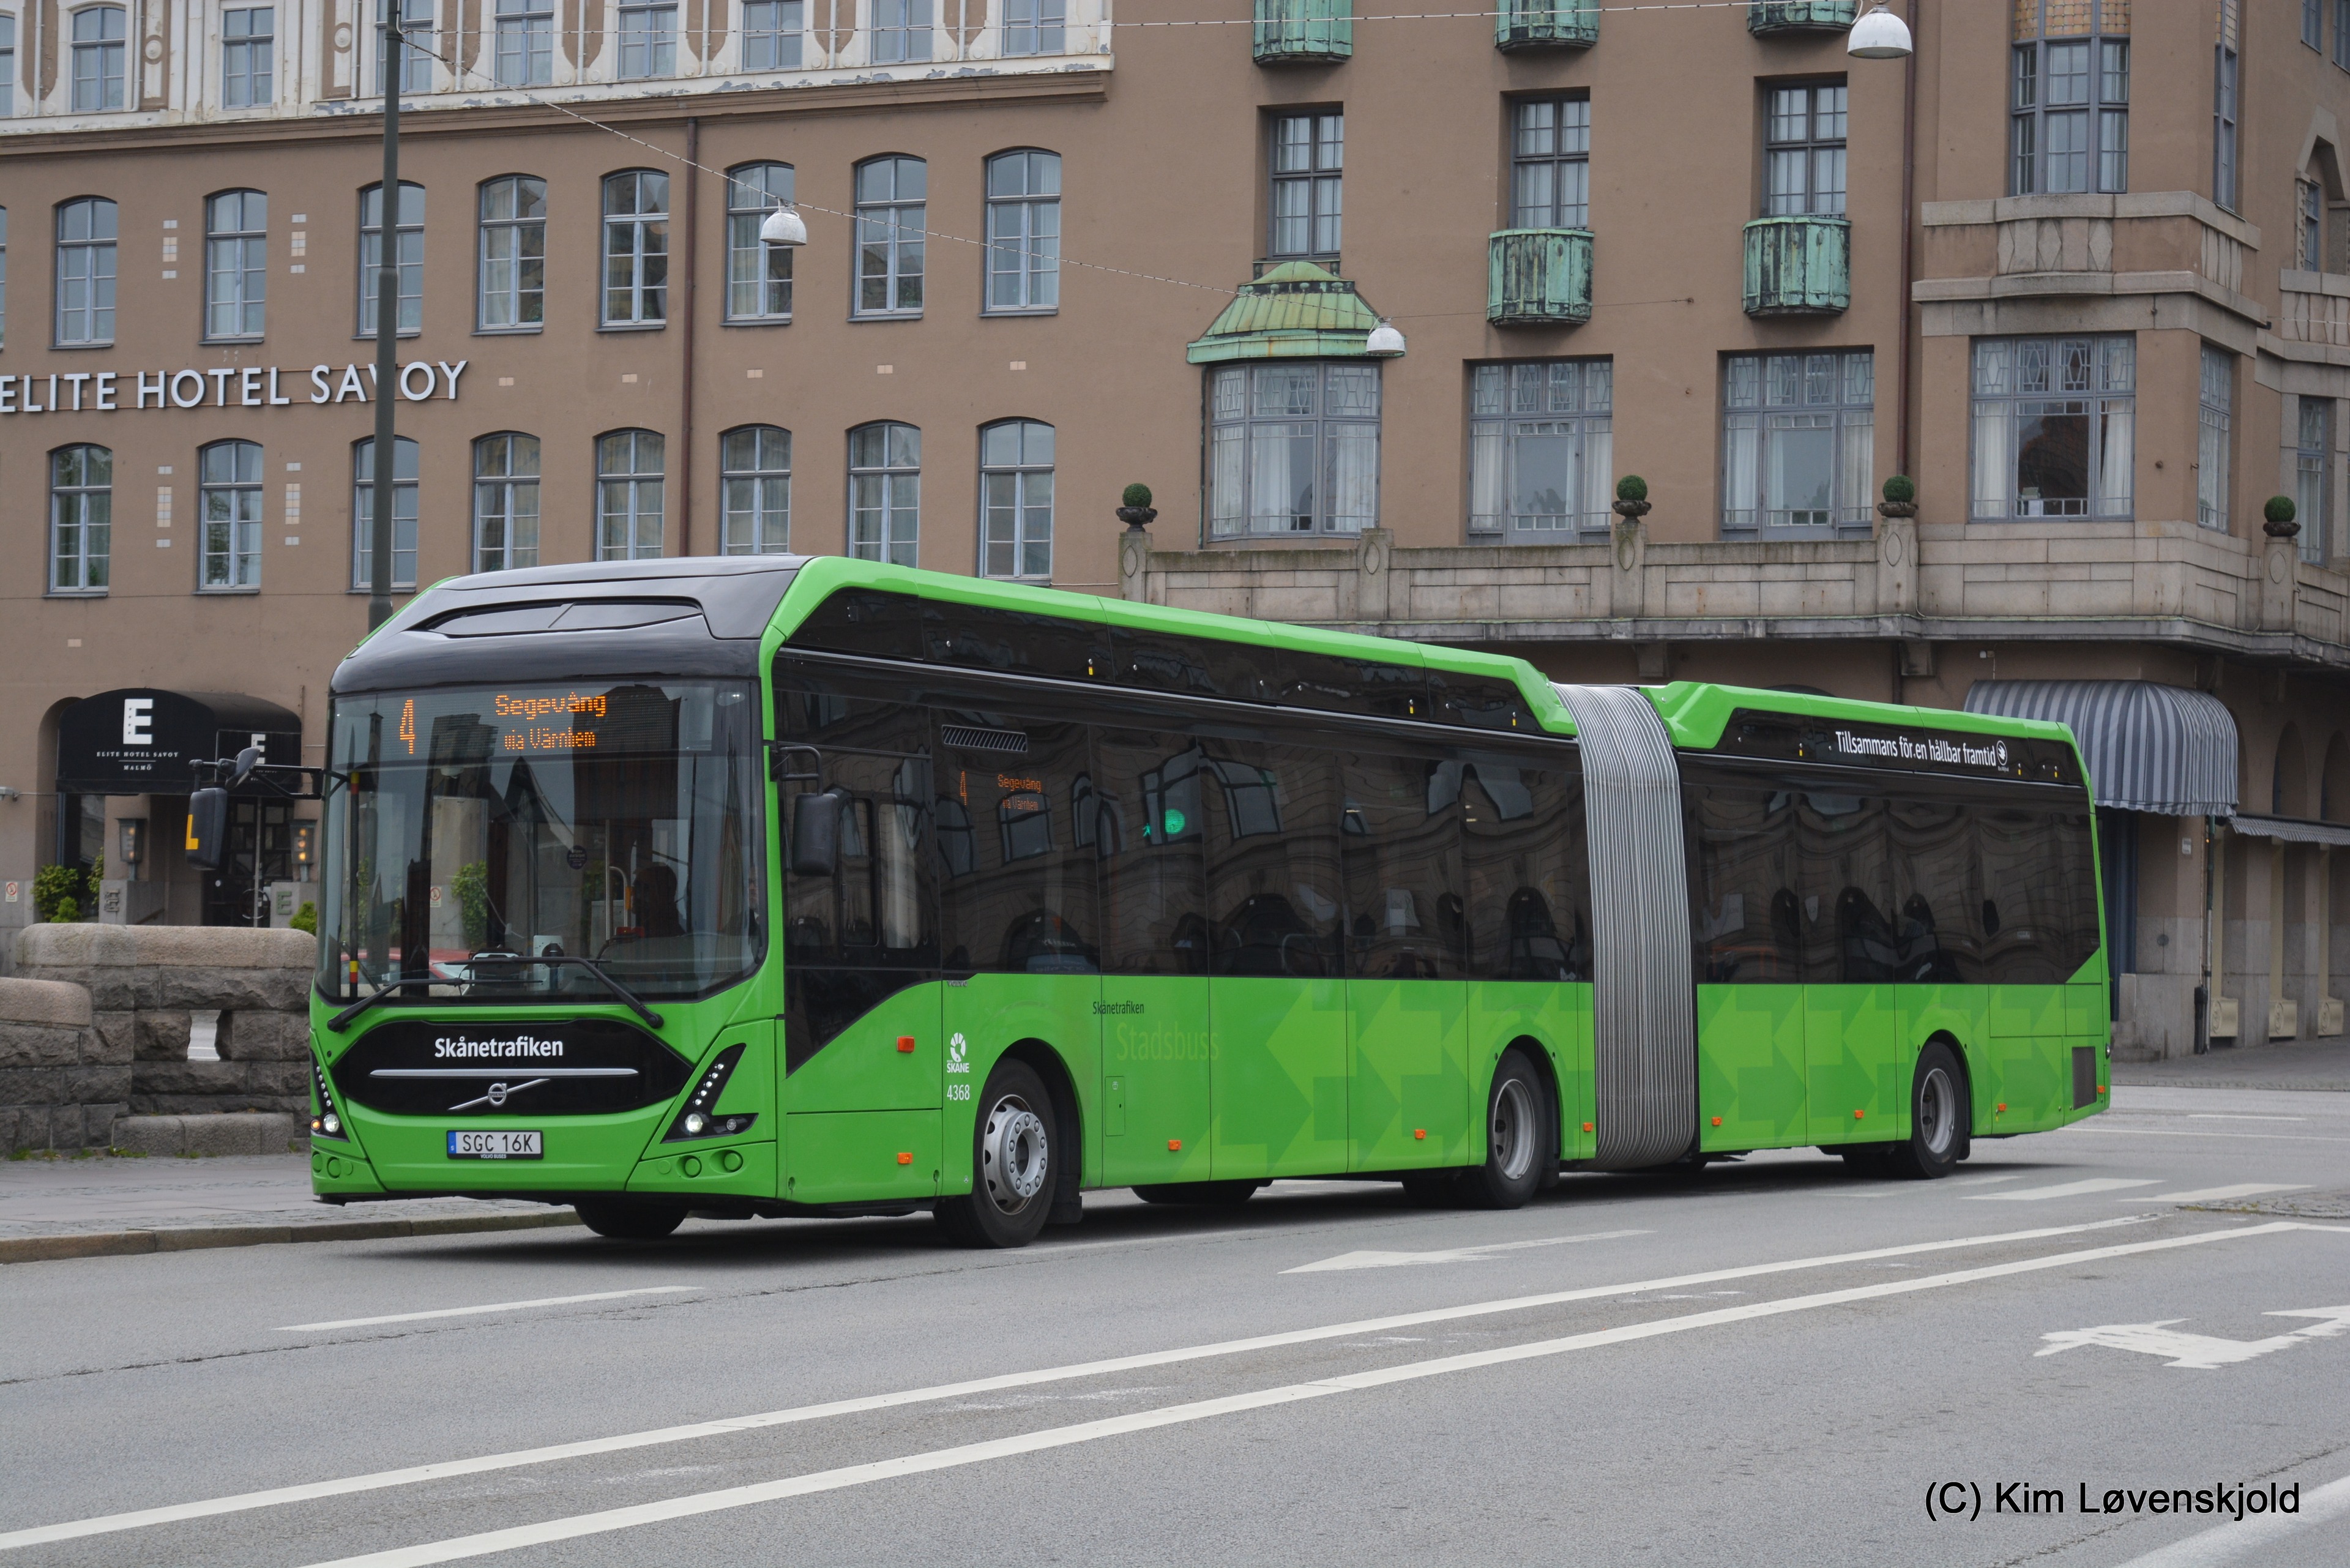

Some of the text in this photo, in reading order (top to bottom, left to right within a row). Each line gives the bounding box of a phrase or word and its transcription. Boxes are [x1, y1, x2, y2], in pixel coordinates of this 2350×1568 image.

[0, 372, 116, 413] ELITE
[137, 367, 290, 408] HOTEL
[123, 699, 153, 744] E
[400, 692, 606, 754] 4 Segevång
[504, 727, 596, 750] via Värnhem
[1835, 731, 1996, 766] Tillsammans för en hållbar framtid
[960, 771, 967, 805] 4
[1092, 999, 1144, 1015] Skånetrafiken
[435, 1036, 564, 1058] Skånetrafiken
[1116, 1020, 1220, 1061] Stadsbuss
[947, 1085, 970, 1100] 4368
[463, 1134, 533, 1152] SGC 16K
